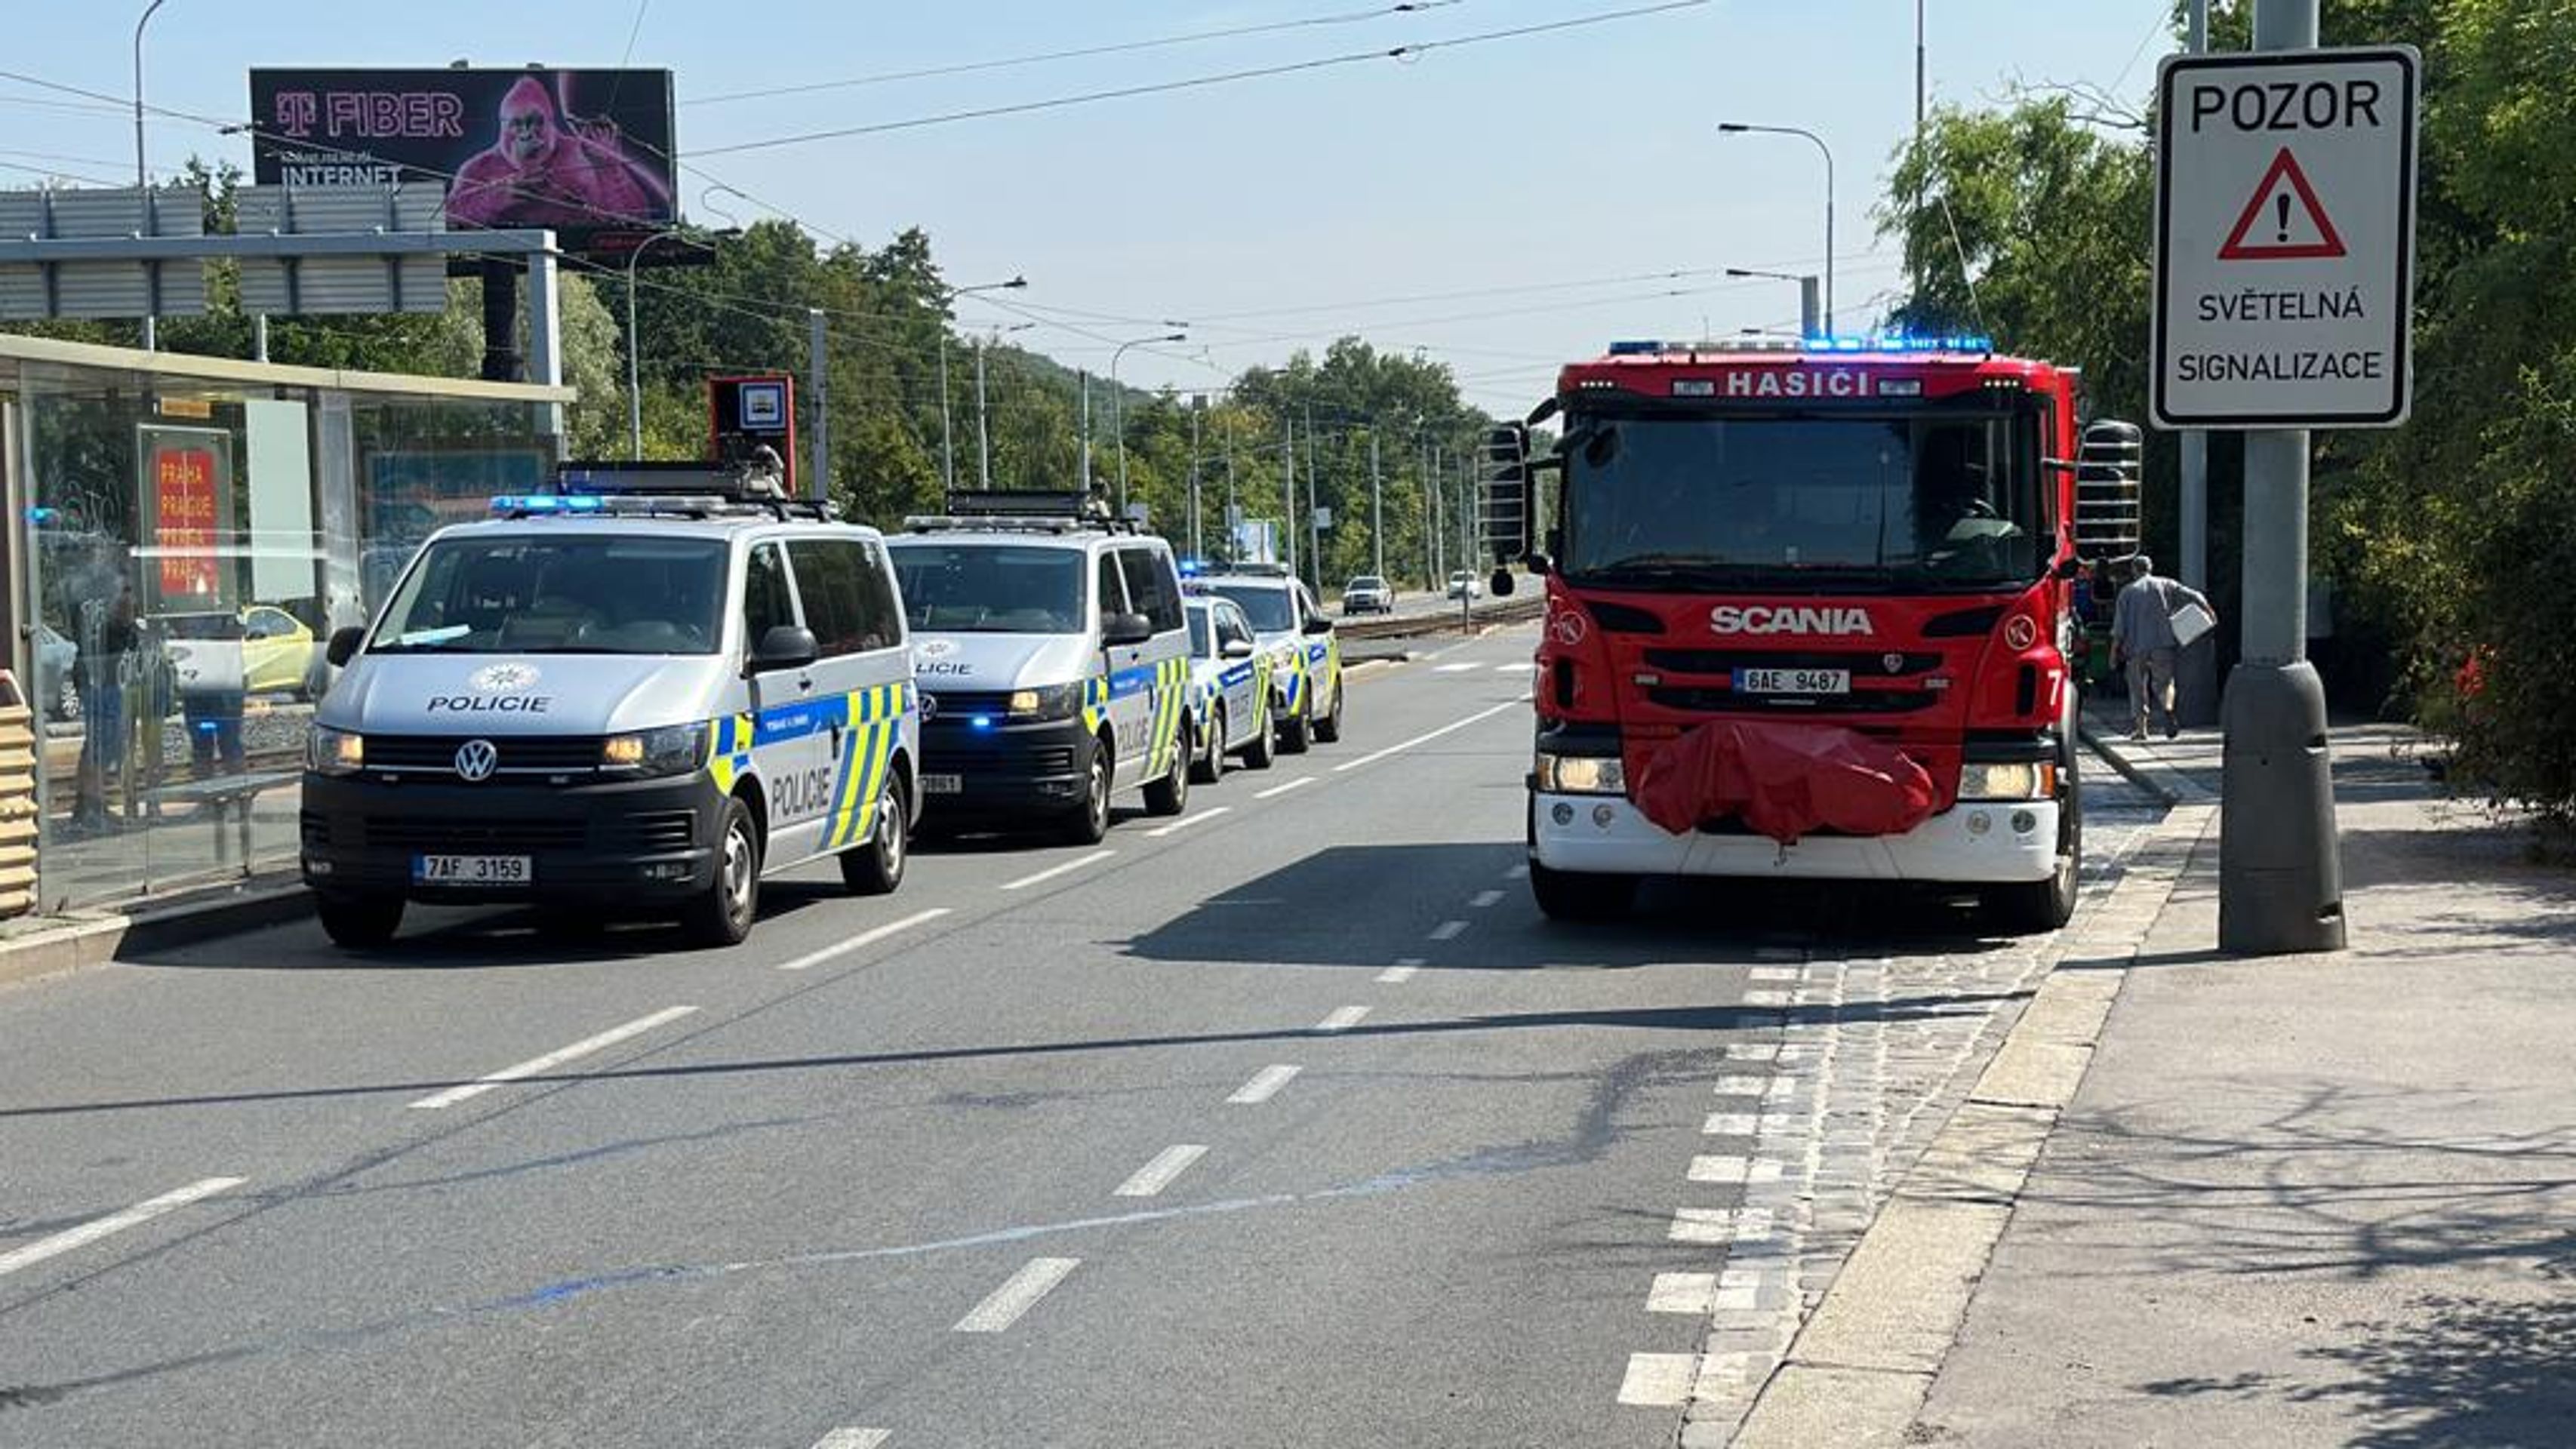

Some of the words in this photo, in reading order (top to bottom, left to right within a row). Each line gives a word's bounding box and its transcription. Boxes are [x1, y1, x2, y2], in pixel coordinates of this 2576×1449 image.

[277, 92, 315, 137] T
[327, 92, 463, 137] FIBER
[2193, 79, 2379, 132] POZOR
[282, 165, 404, 189] INTERNET
[2199, 285, 2364, 321] SVĚTELNÁ
[2178, 352, 2381, 381] SIGNALIZACE
[1728, 368, 1868, 396] HASIČI
[161, 463, 202, 483] PRAHA
[161, 495, 212, 517] PRAGUE
[1710, 606, 1873, 635] SCANIA
[916, 663, 972, 675] LICIE
[1748, 672, 1782, 691] 6AE
[1796, 672, 1840, 691] 9487
[2048, 669, 2061, 706] 7
[428, 696, 555, 712] POLICIE
[772, 767, 829, 819] POLICIE
[429, 858, 462, 877] 7AF
[475, 860, 522, 878] 3159
